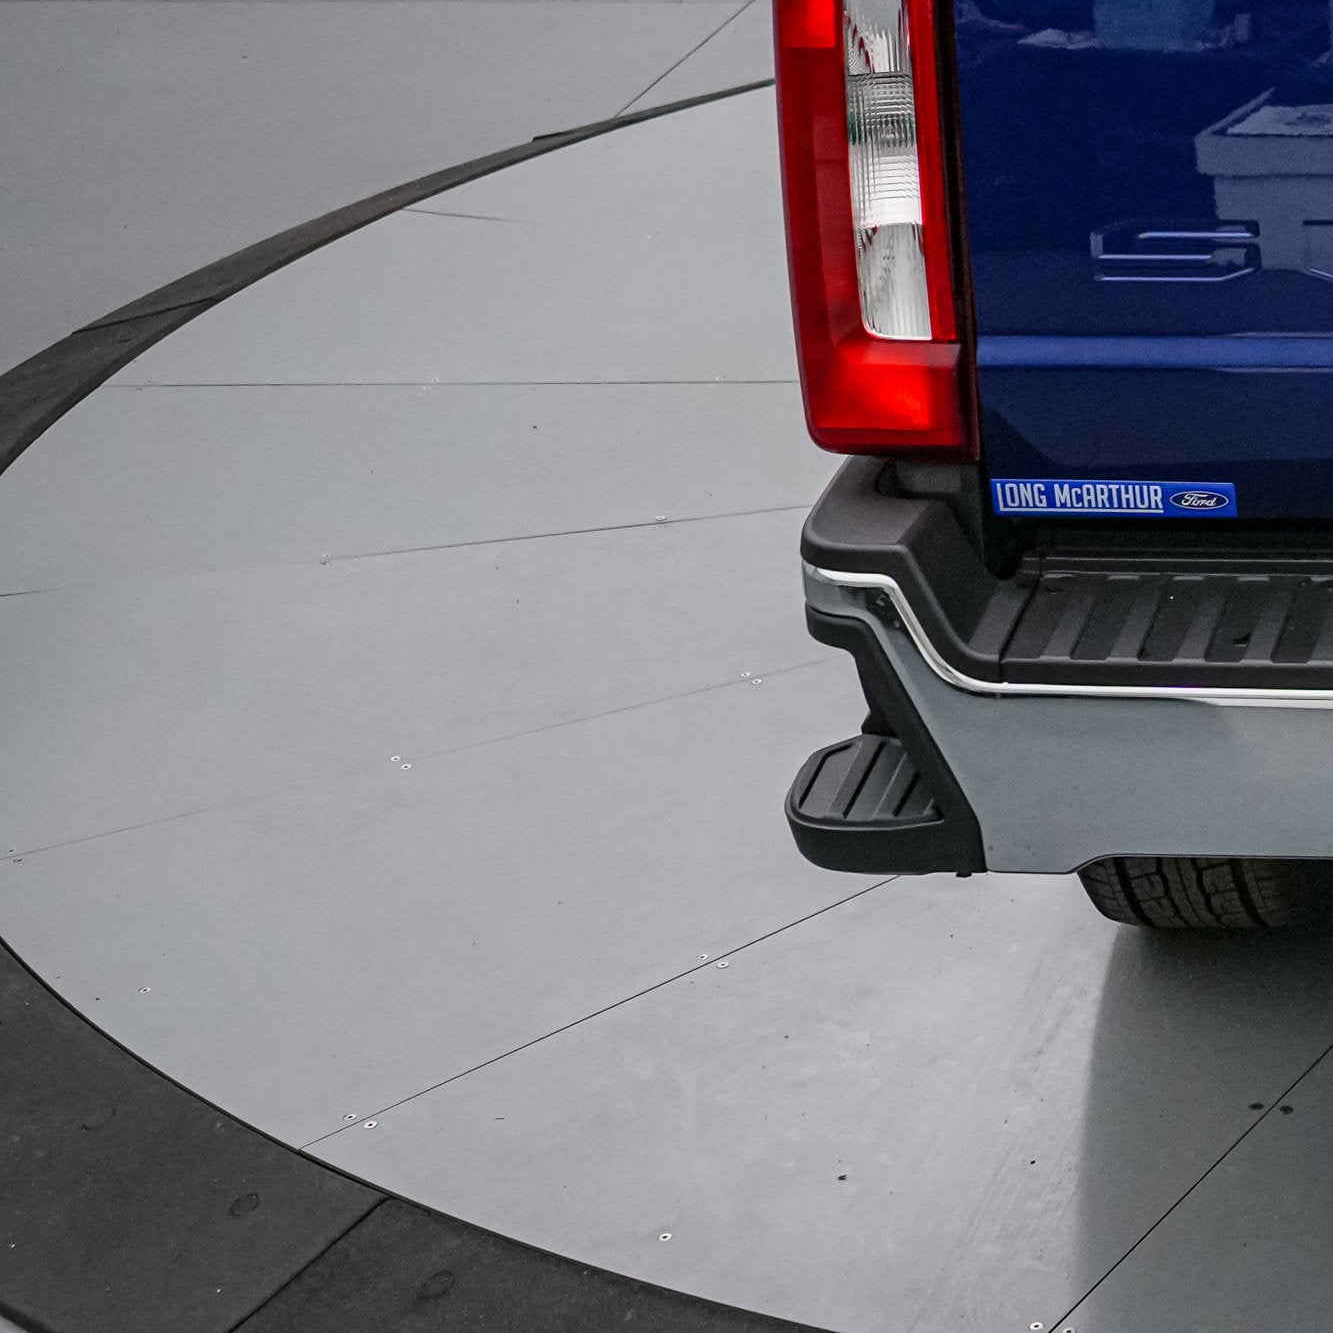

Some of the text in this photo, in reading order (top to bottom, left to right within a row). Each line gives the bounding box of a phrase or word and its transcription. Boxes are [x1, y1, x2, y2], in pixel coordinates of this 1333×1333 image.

[998, 483, 1164, 511] LONG McARTHUR
[1181, 494, 1217, 507] Ford
